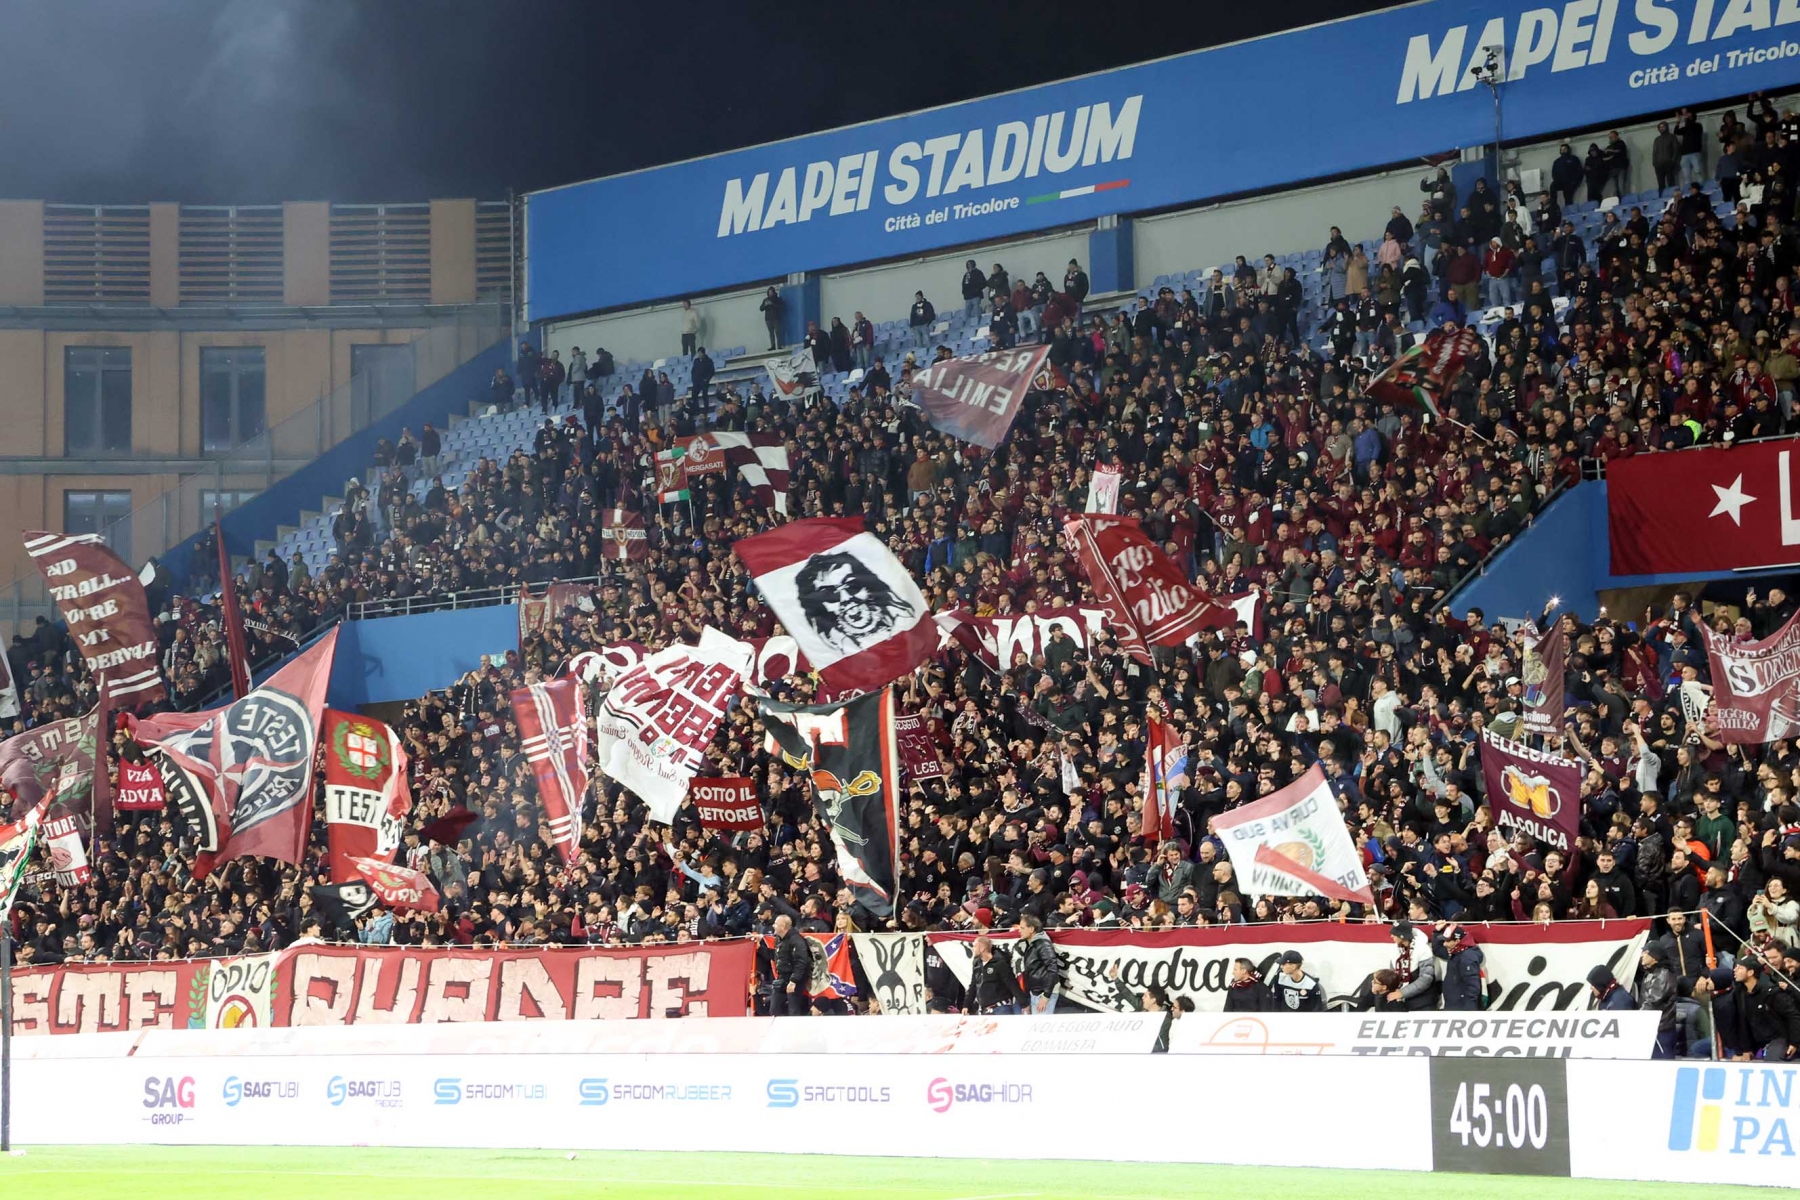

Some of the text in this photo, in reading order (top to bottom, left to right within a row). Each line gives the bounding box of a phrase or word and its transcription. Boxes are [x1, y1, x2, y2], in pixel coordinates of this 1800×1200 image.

[1396, 0, 1619, 105] MAPEI
[1629, 41, 1800, 89] Città del Tricolo
[718, 95, 1143, 238] MAPEI STADIUM
[885, 195, 1020, 232] Città del Tricolore
[1717, 708, 1757, 720] EGGIO
[127, 769, 153, 782] VIA
[693, 786, 756, 803] SOTTO IL
[698, 805, 760, 823] SETTORE
[1498, 809, 1568, 850] ALCOLICA
[211, 960, 270, 1003] ODIO
[1104, 1019, 1144, 1032] AUTO
[1356, 1018, 1621, 1040] ELETTROTECNICA
[142, 1076, 196, 1109] SAG
[1733, 1068, 1800, 1108] IN
[151, 1113, 184, 1126] GROUP
[1449, 1081, 1548, 1150] 45:00
[1729, 1115, 1800, 1156] PA
